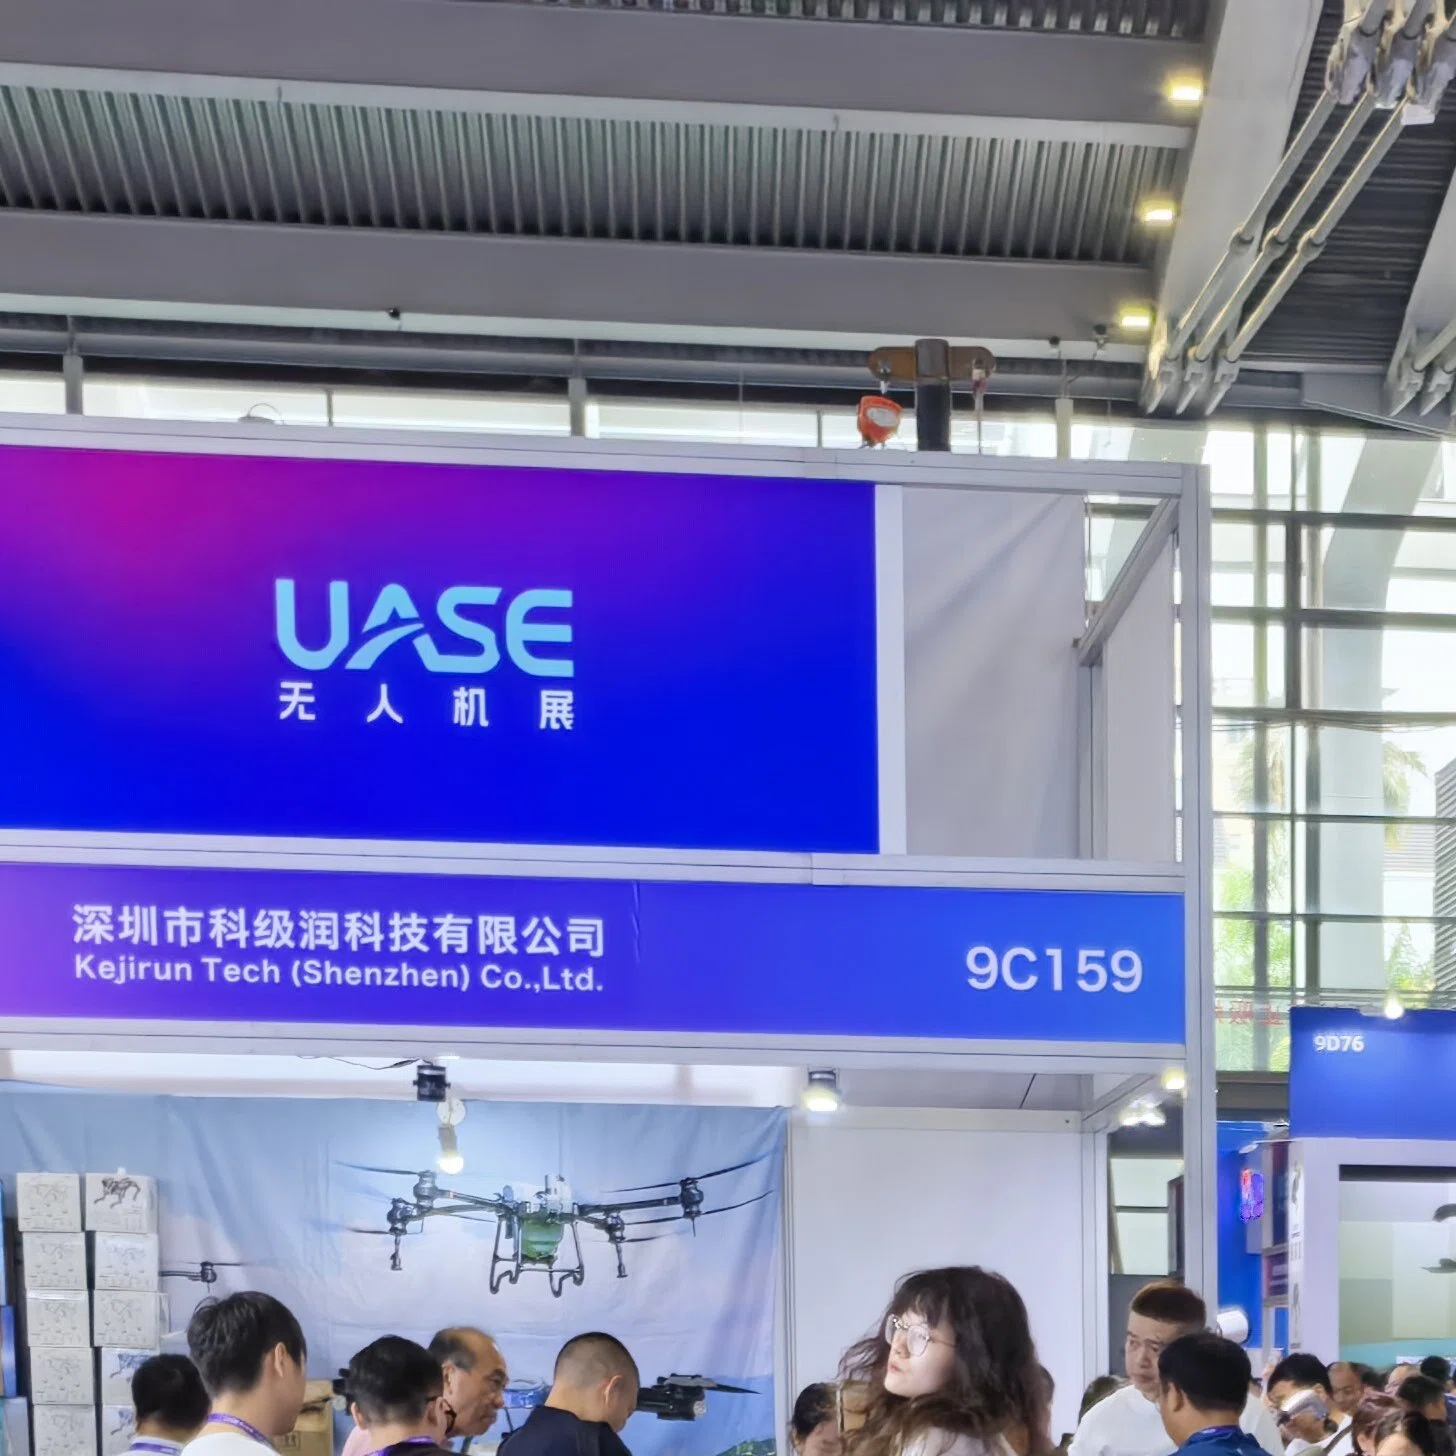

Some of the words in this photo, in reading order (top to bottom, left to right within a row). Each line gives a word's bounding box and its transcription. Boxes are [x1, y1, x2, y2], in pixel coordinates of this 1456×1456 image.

[275, 579, 574, 677] UASE
[279, 681, 576, 732] 无人机展
[72, 903, 606, 959] 深圳市科级润科技有限公司
[75, 955, 194, 987] Kejirun
[201, 956, 280, 985] Tech
[292, 957, 471, 991] (Shenzhen)
[482, 961, 604, 993] Co.,Ltd.
[966, 946, 1144, 994] 9C159
[1313, 1034, 1365, 1053] 9D76
